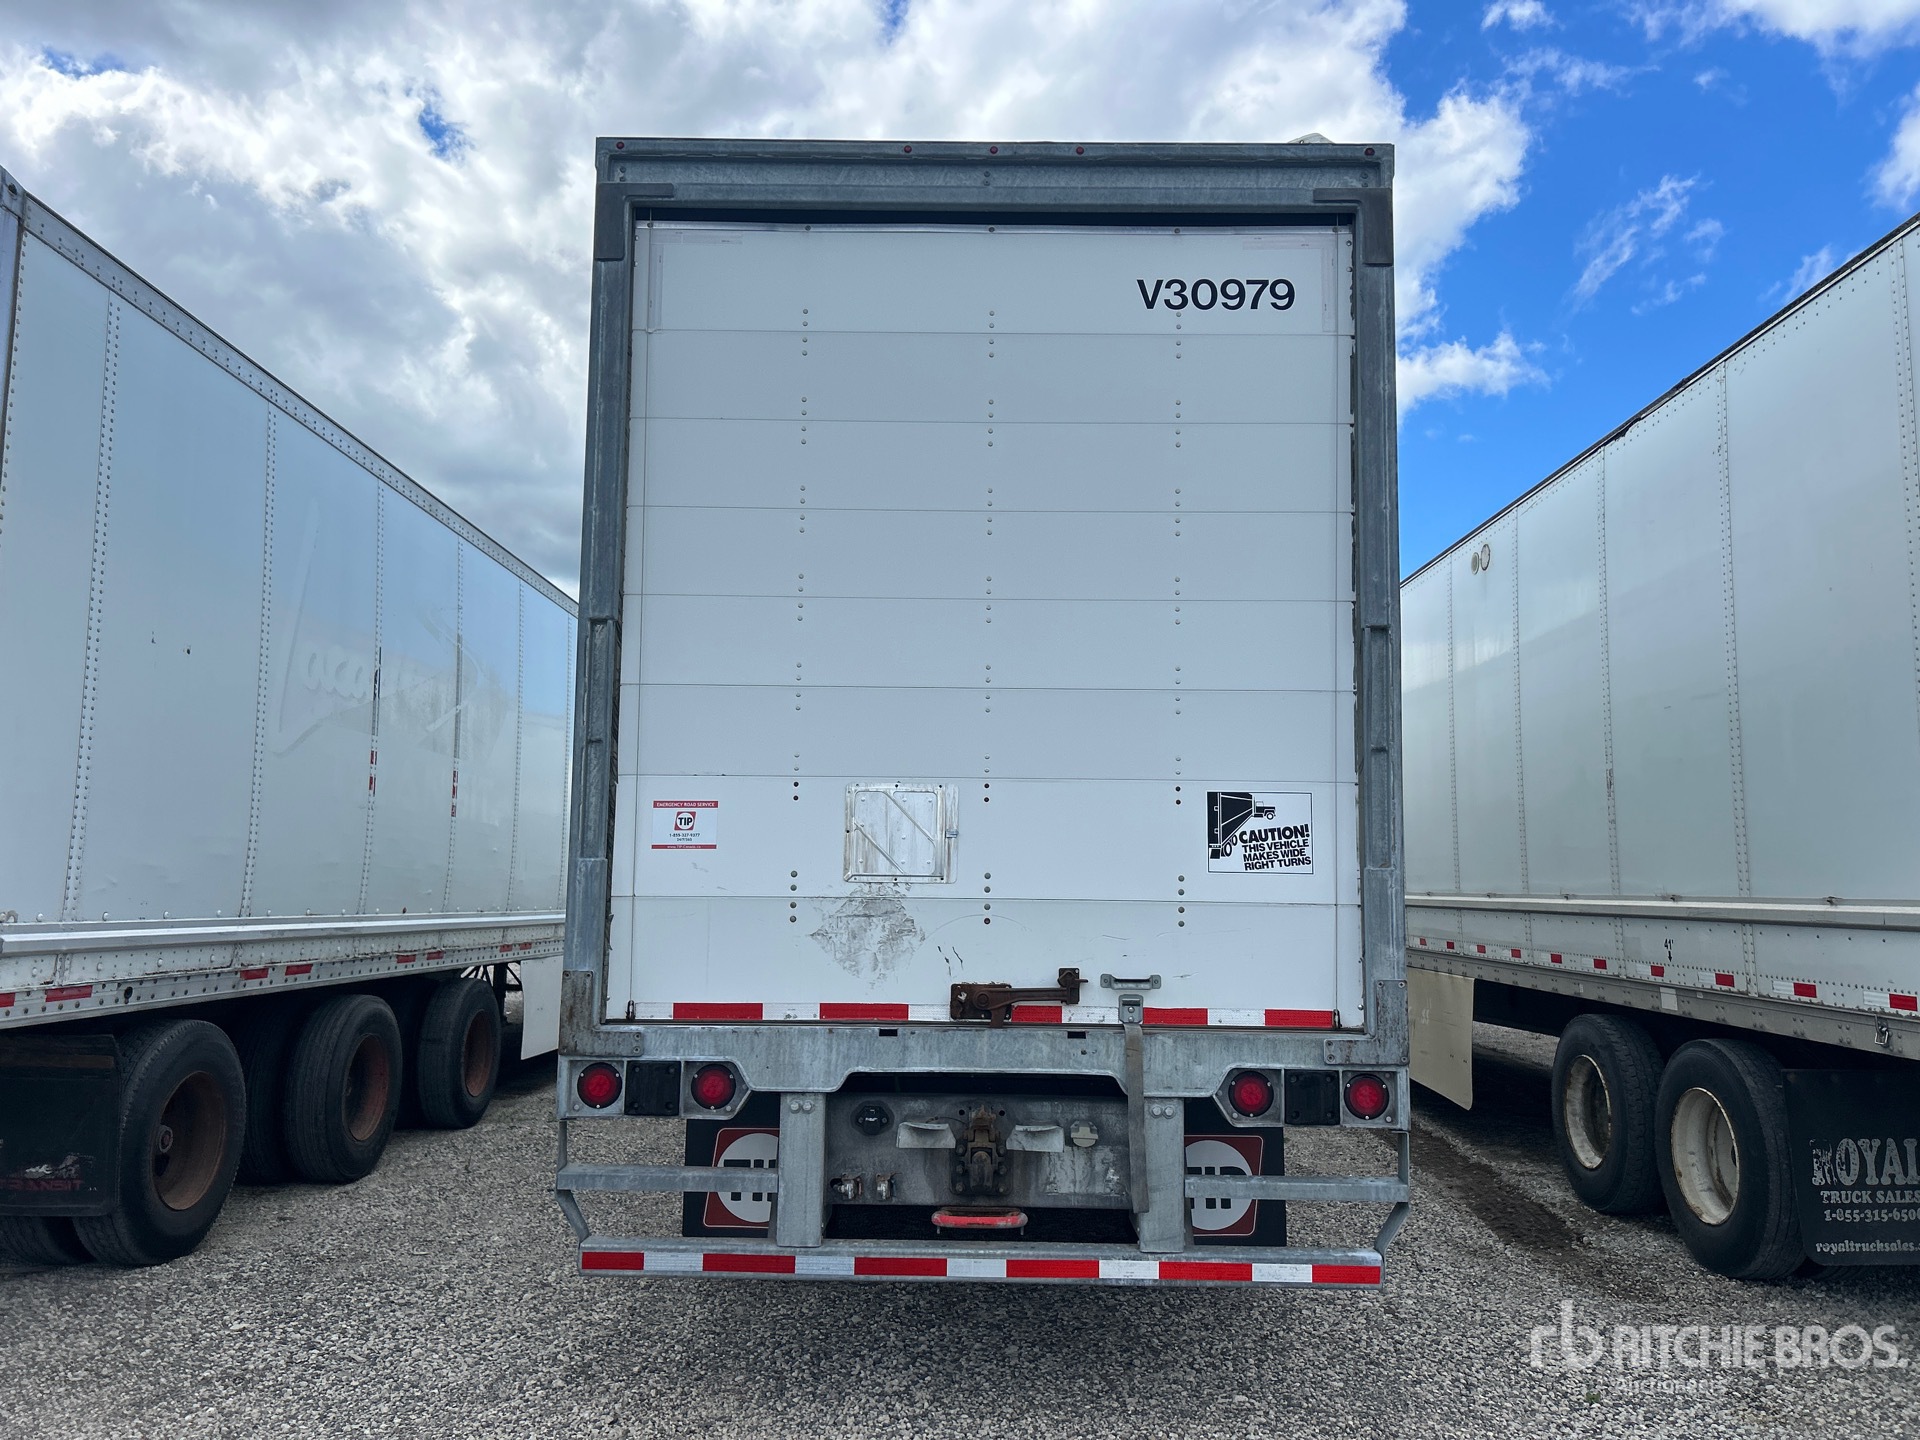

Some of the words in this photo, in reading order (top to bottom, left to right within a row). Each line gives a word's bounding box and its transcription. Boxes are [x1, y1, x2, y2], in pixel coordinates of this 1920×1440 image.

[1136, 278, 1296, 311] V30979
[677, 817, 693, 826] TIP
[1238, 823, 1310, 844] CAUTION!
[1241, 842, 1266, 853] THIS
[1266, 838, 1310, 850] VEHICLE
[1243, 850, 1280, 862] MAKES
[1280, 847, 1307, 859] WIDE
[1244, 859, 1275, 871] RIGHT
[1277, 856, 1312, 868] TURNS
[1820, 1190, 1873, 1204] TRUCK
[1875, 1190, 1920, 1204] SALES
